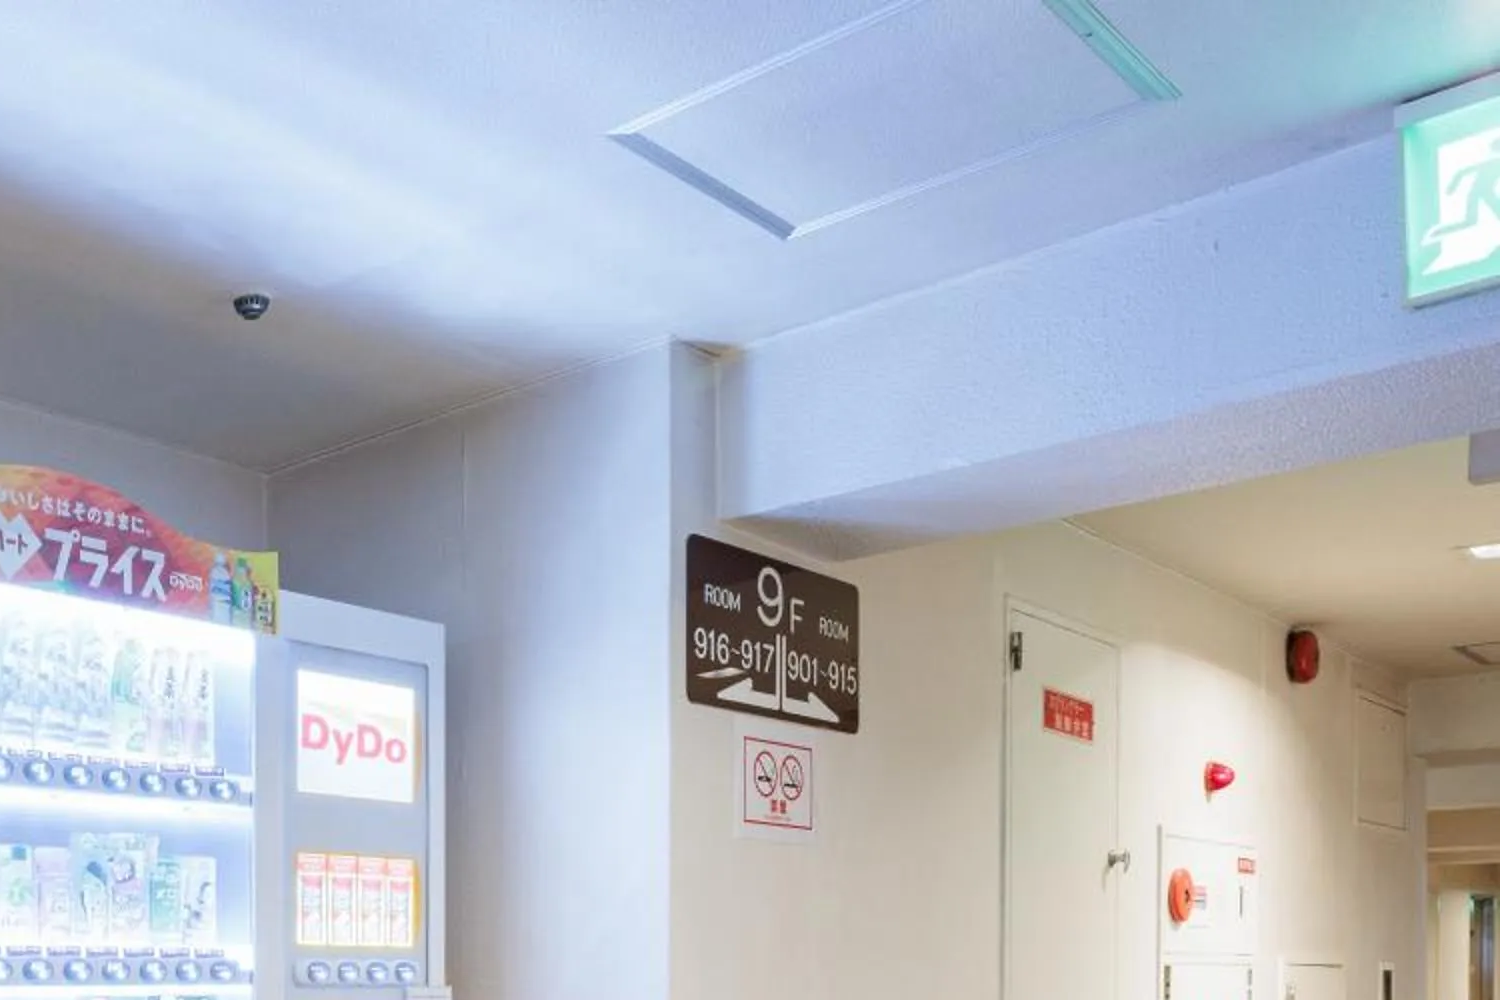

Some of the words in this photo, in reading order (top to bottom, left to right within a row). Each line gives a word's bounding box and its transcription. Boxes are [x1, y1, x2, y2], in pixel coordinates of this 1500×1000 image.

[44, 527, 168, 602] プライス
[704, 583, 741, 612] ROOM
[819, 616, 849, 644] ROOM
[301, 713, 407, 766] DyDo
